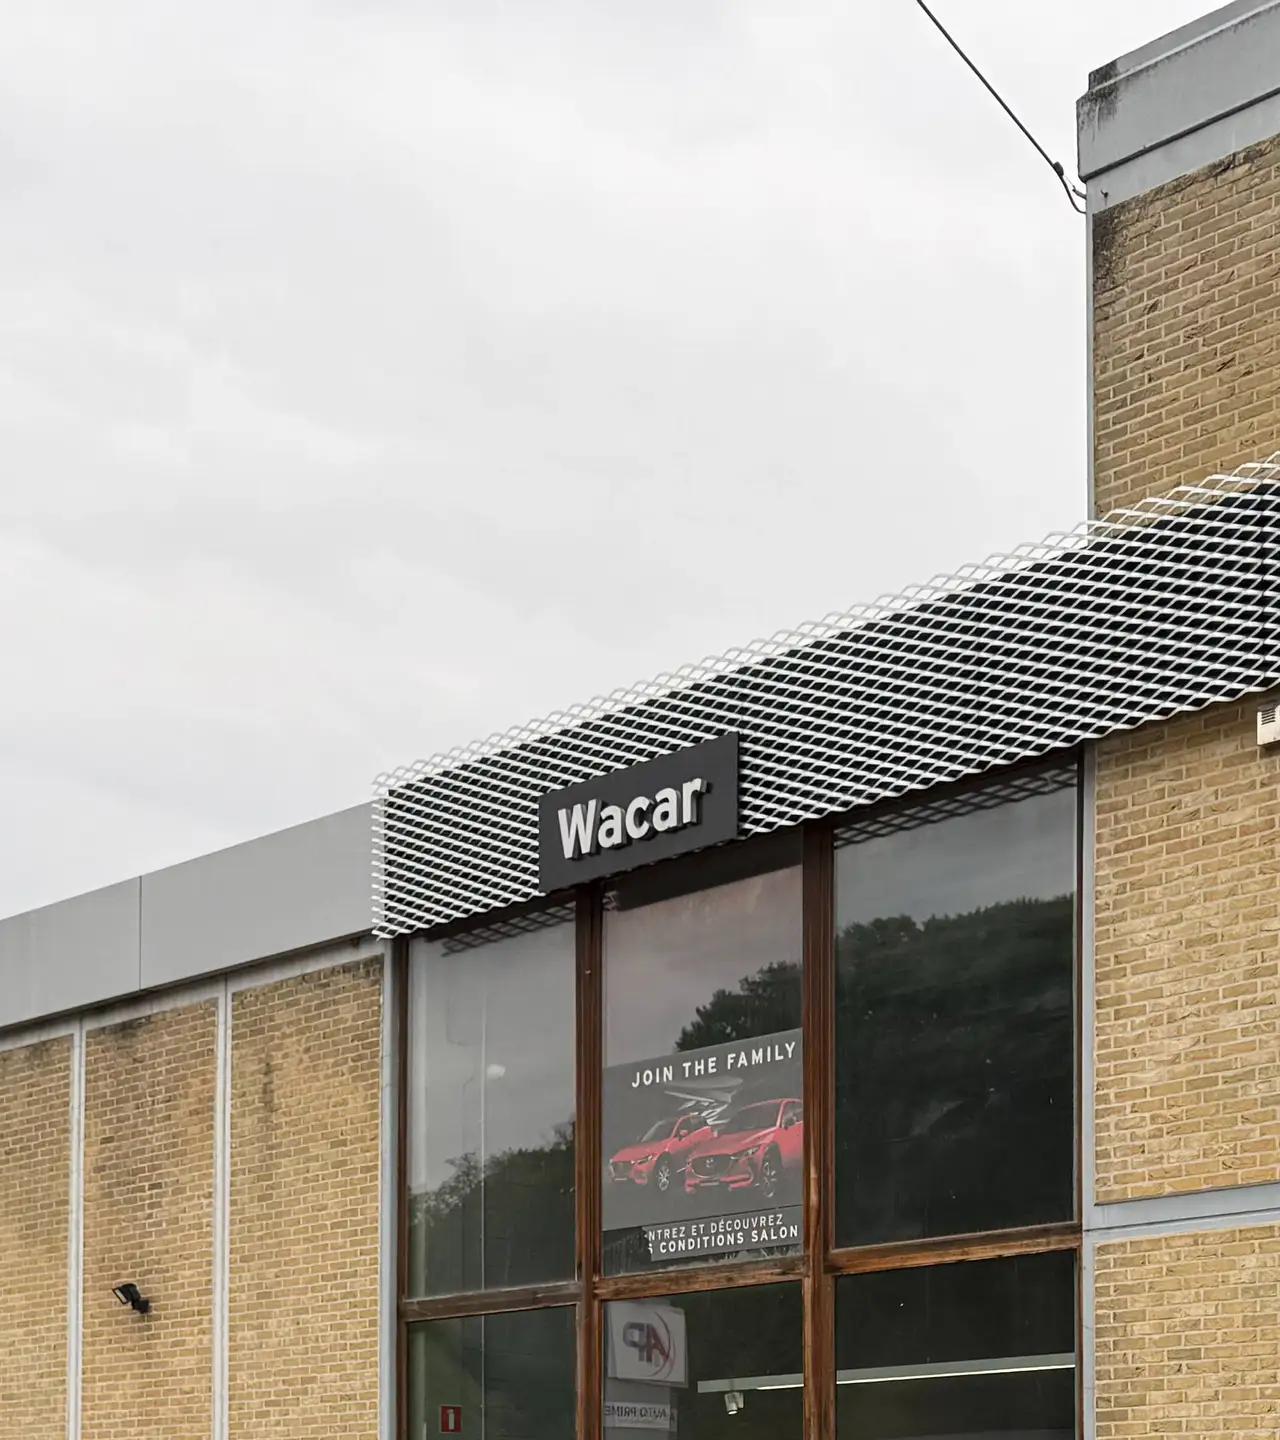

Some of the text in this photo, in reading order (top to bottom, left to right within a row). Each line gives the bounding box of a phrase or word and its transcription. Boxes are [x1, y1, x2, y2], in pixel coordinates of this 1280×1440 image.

[556, 777, 708, 860] Wacar
[631, 1041, 796, 1089] JOIN THE FAMILY
[644, 1213, 784, 1241] NTREZ ET DÉCOUVREZ
[659, 1231, 744, 1254] CONDITIONS
[751, 1224, 799, 1243] SALON
